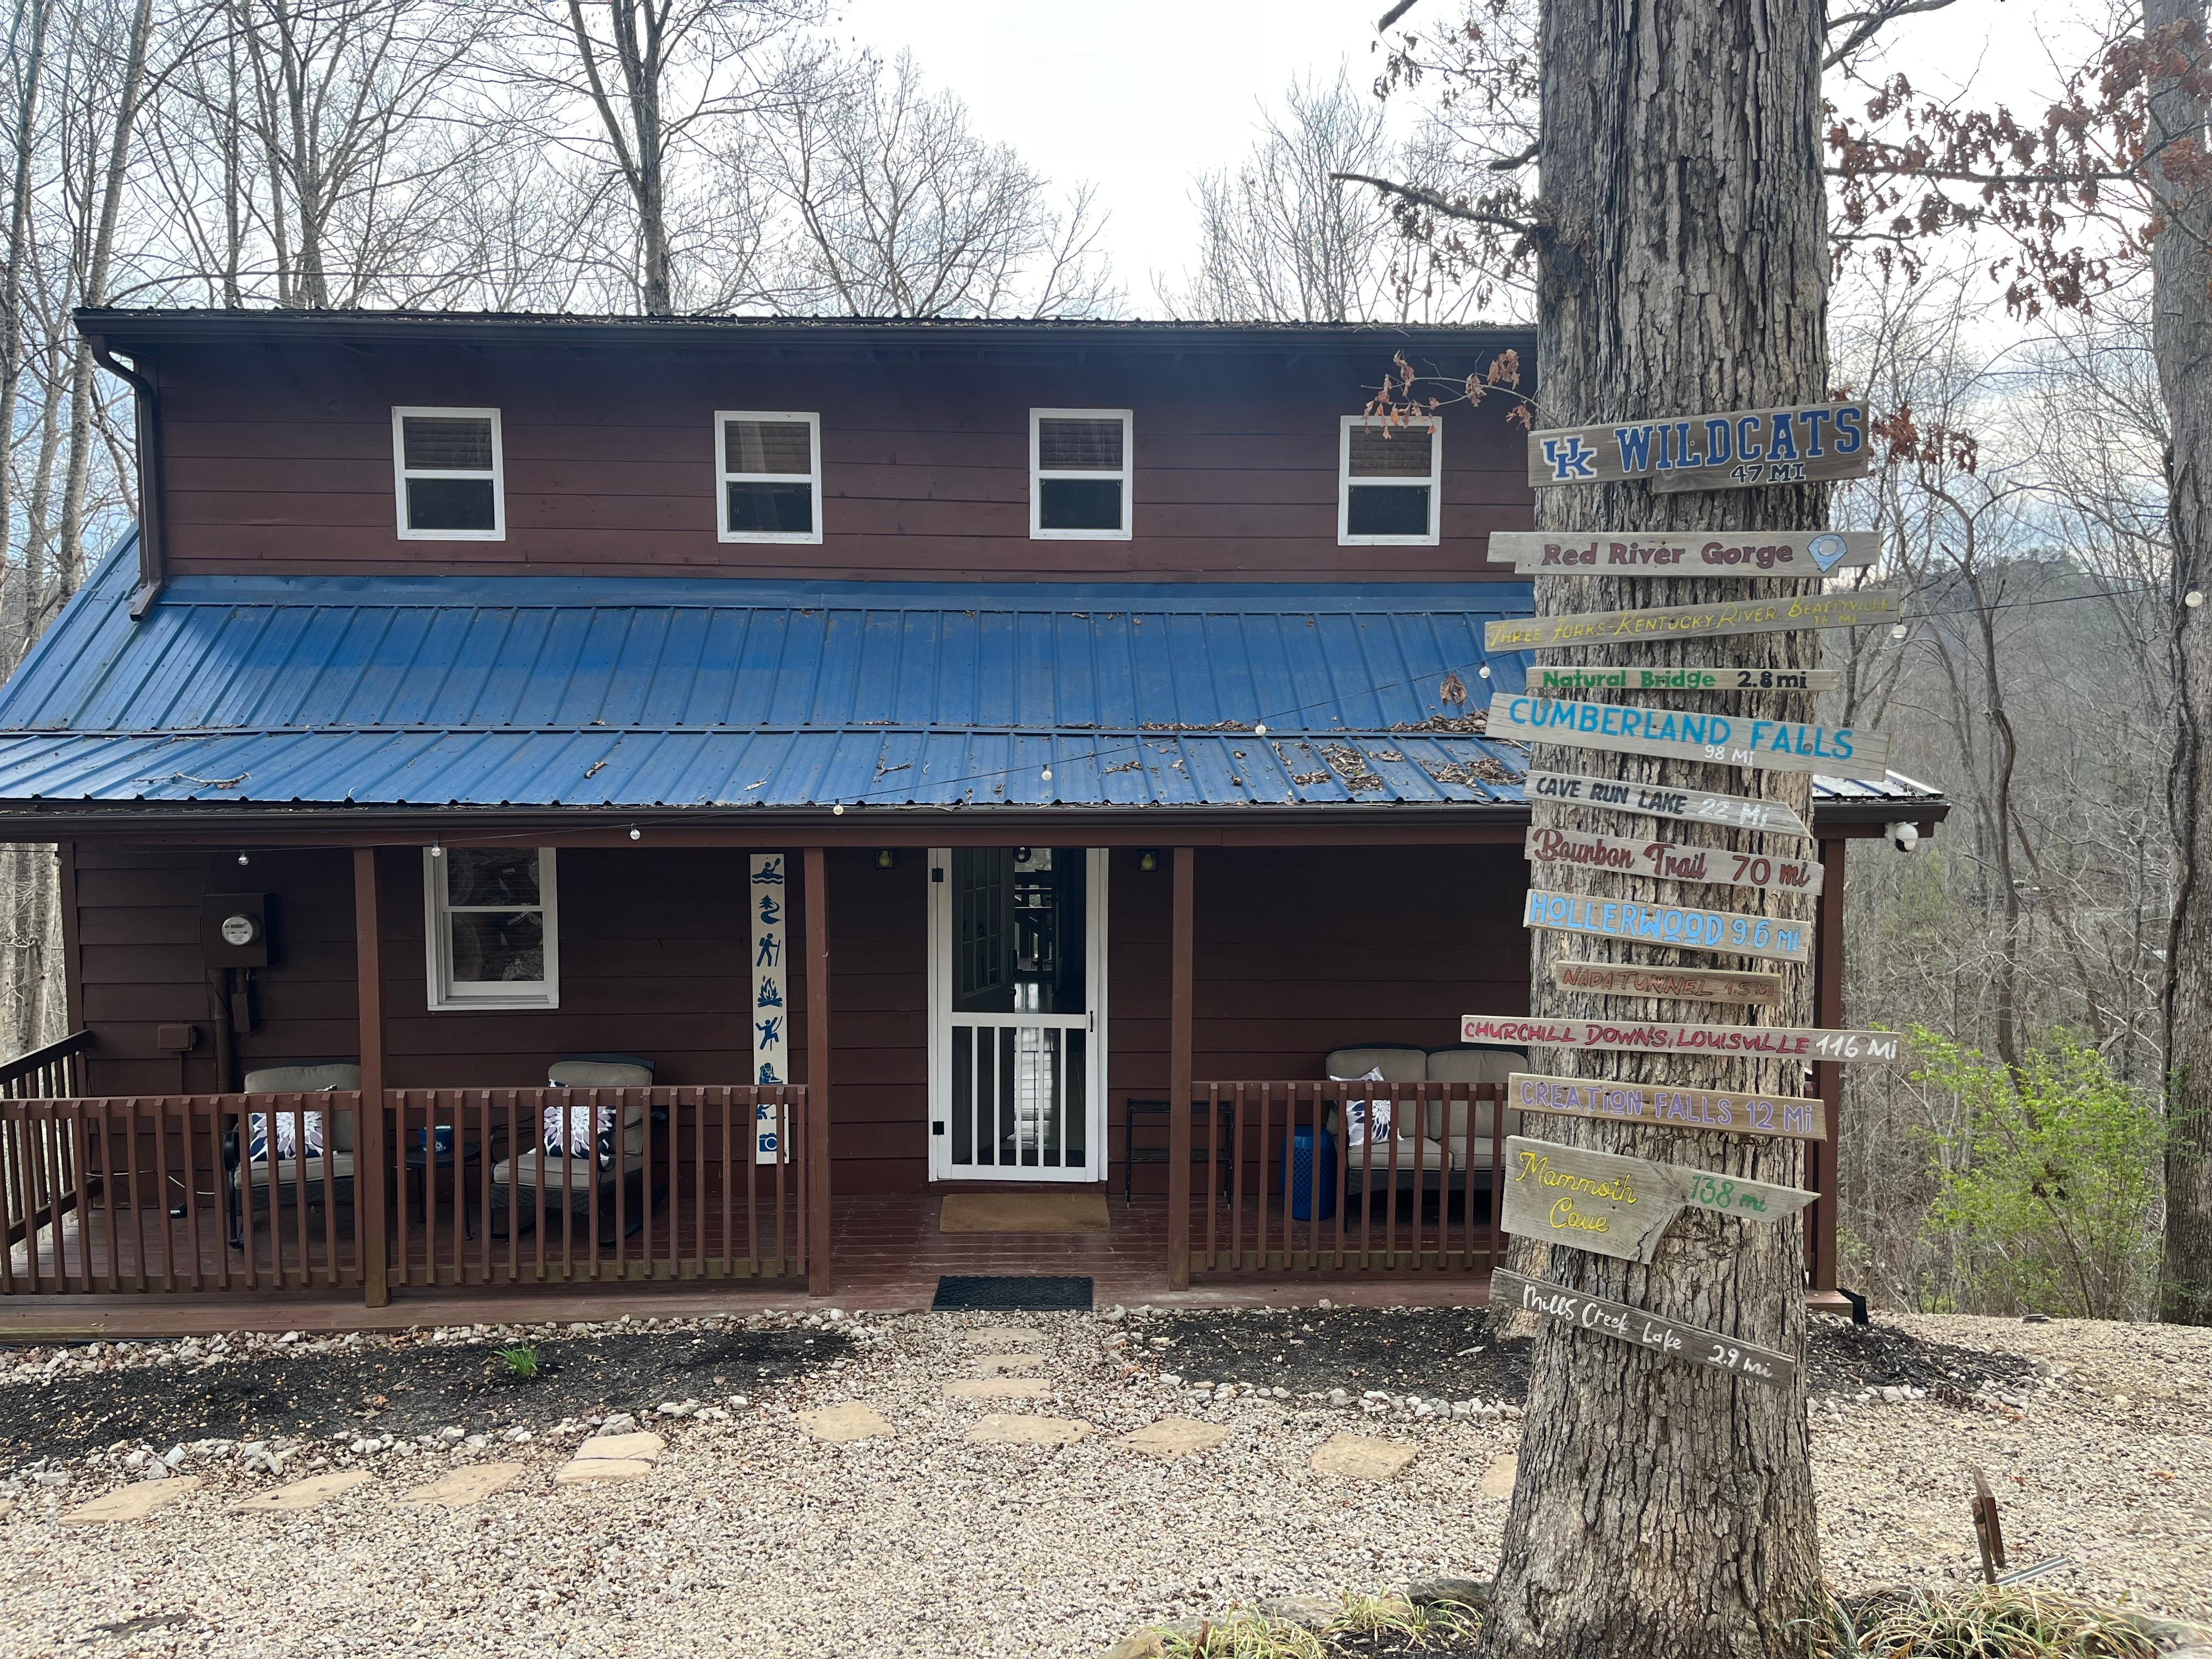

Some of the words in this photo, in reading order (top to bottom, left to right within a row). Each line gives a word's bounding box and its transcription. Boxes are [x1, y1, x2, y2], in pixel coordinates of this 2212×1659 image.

[1543, 435, 1598, 482] UK
[1613, 407, 1861, 472] WILDCATS
[1730, 465, 1763, 483] 47
[1767, 462, 1806, 482] MI
[1541, 542, 1598, 566] Red
[1608, 542, 1685, 565] River
[1701, 541, 1793, 569] Gorge
[1488, 622, 1542, 647] THREE
[1788, 596, 1889, 618] BEATTYVILLE
[1814, 615, 1829, 627] 16
[1838, 614, 1857, 625] MI
[1543, 670, 1626, 688] Natural
[1640, 670, 1716, 689] Bridge
[1510, 698, 1731, 745] CUMBERLAND
[1750, 720, 1854, 760] FALLS
[1704, 744, 1725, 761] 98
[1731, 748, 1755, 766] MI
[1536, 776, 1582, 798] CAVE
[1589, 783, 1629, 804] RUN
[1638, 789, 1688, 815] LAKE
[1697, 798, 1731, 820] 22
[1532, 828, 1635, 869] Bourbon
[1643, 843, 1707, 879] Trail
[1732, 855, 1770, 885] 70
[1779, 861, 1810, 888] mi
[1529, 892, 1724, 946] HOLLERWOOD
[1732, 918, 1770, 948] 9.6
[1563, 966, 1613, 990] NADA
[1618, 970, 1713, 996] TUNNEL
[1724, 979, 1752, 996] 1.5
[1464, 1022, 1576, 1042] CHURCHILL
[1676, 1028, 1810, 1054] LOUISVILLE
[1815, 1034, 1858, 1058] 116
[1655, 1092, 1733, 1125] FALLS
[1746, 1101, 1774, 1130] 12
[1514, 1152, 1638, 1205] Mammoth
[1690, 1175, 1735, 1209] 138
[1740, 1194, 1767, 1212] mi
[1549, 1197, 1610, 1233] Cave
[1582, 1302, 1632, 1335] Creek
[1642, 1321, 1682, 1352] Lake
[1707, 1345, 1740, 1369] 2.9
[1743, 1357, 1773, 1378] mi
